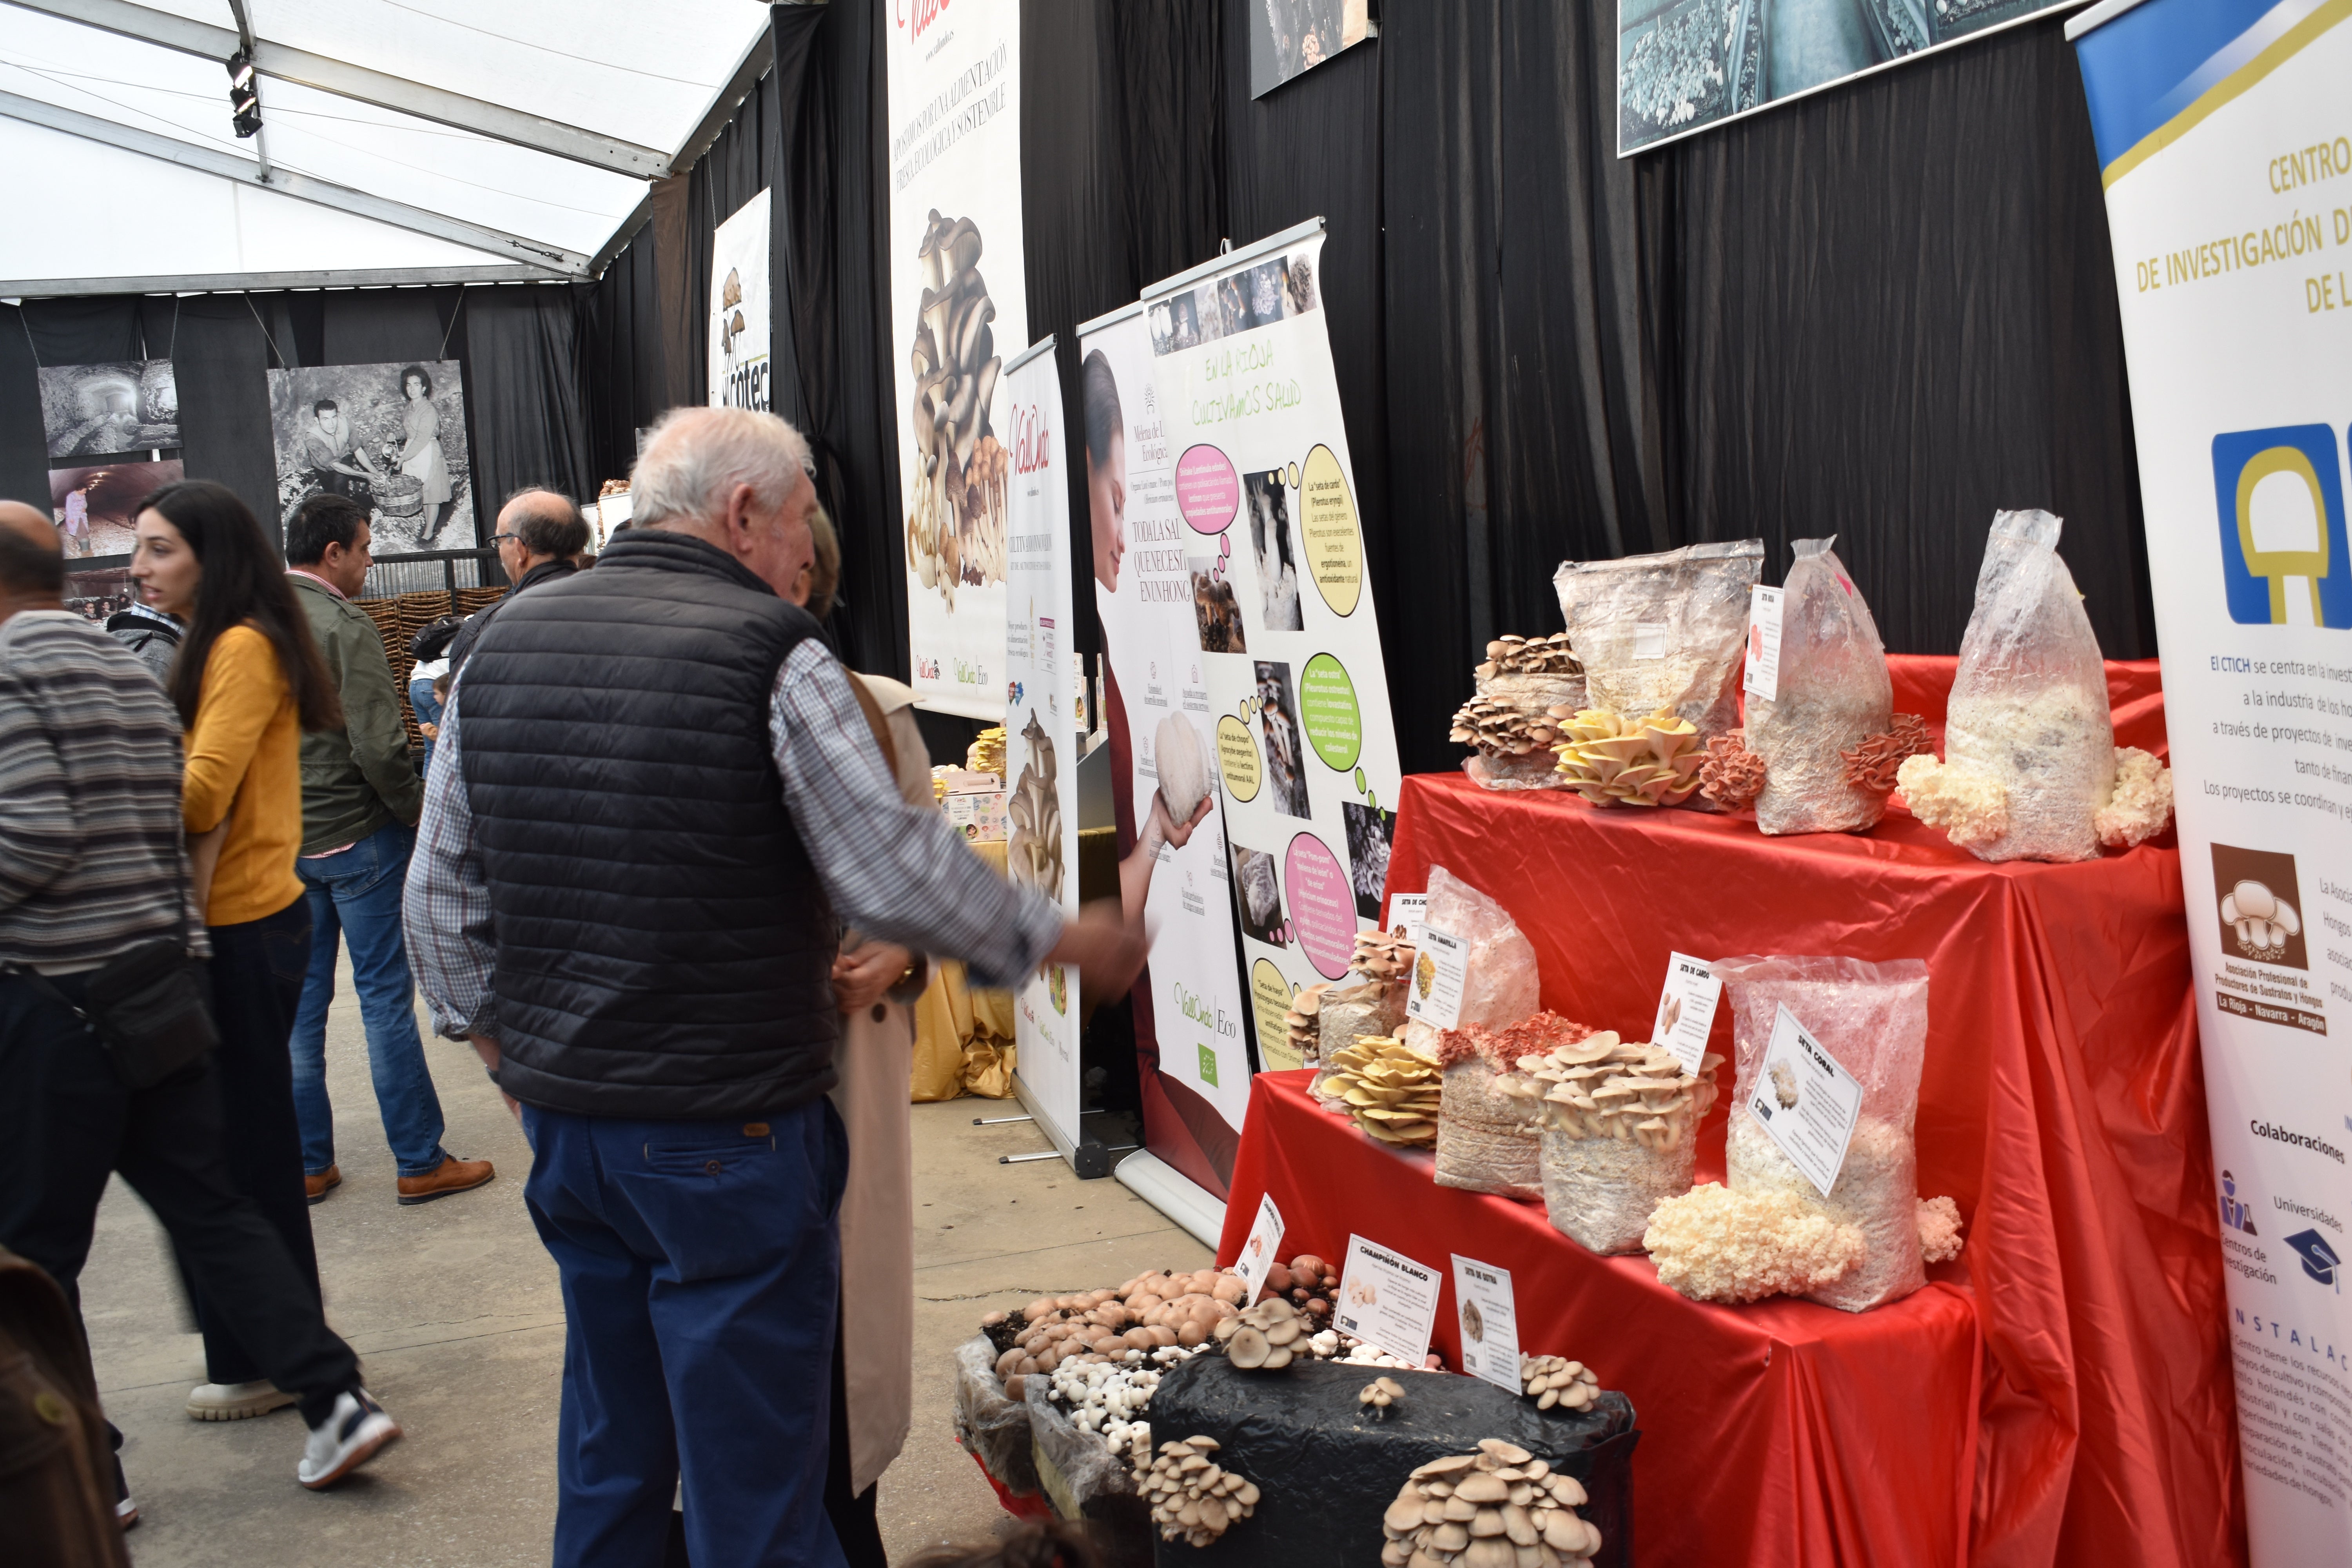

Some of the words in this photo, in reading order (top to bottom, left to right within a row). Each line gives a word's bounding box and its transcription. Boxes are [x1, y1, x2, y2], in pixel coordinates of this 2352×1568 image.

[894, 113, 922, 164] APOSTAMOS
[922, 102, 935, 135] POR
[934, 90, 948, 119] UNA
[949, 38, 1007, 111] ALIMENTACIÓN
[915, 126, 951, 175] ECOLÓGICA
[951, 118, 956, 145] Y
[956, 82, 1006, 140] SOSTENIBLE
[2269, 137, 2351, 194] CENTRO
[2136, 257, 2161, 293] DE
[2166, 209, 2323, 286] INVESTIGACIÓN
[2305, 274, 2334, 313] DE
[2339, 271, 2352, 307] L
[1222, 350, 1233, 377] LA
[1236, 339, 1274, 374] RIOJA
[1192, 385, 1260, 426] CULTIVAMOS
[1266, 378, 1301, 411] SALUD
[1152, 423, 1159, 439] de
[1132, 520, 1152, 542] TODA
[1152, 518, 1164, 542] LA
[1165, 518, 1182, 540] SAL
[1325, 543, 1338, 553] fuentes
[1134, 550, 1150, 577] QUE
[1150, 549, 1187, 572] NECESIT
[1140, 581, 1152, 602] EN
[1151, 580, 1162, 602] UN
[1162, 580, 1191, 603] HONG
[1319, 574, 1345, 583] antioxidante
[977, 665, 988, 686] Eco
[2210, 655, 2219, 671] El
[2221, 657, 2251, 673] CTICH
[2254, 661, 2267, 674] se
[2270, 660, 2305, 675] centra
[2307, 664, 2318, 677] en
[2318, 661, 2325, 679] la
[2326, 664, 2352, 683] invest
[2243, 694, 2250, 705] a
[2252, 690, 2263, 706] la
[2266, 691, 2313, 710] industria
[2317, 695, 2326, 713] de
[2327, 697, 2339, 716] los
[1310, 713, 1336, 724] compuesto
[1336, 716, 1348, 725] capaz
[1310, 727, 1327, 737] reducir
[1335, 728, 1351, 740] niveles
[2212, 722, 2218, 734] a
[2220, 720, 2250, 737] través
[2253, 722, 2268, 739] de
[2271, 726, 2321, 745] proyectos
[2322, 730, 2332, 747] de
[2335, 733, 2352, 752] inve
[1325, 744, 1348, 755] colesterol
[2295, 759, 2319, 777] tanto
[2321, 763, 2331, 780] de
[2332, 765, 2352, 785] finan
[2204, 779, 2220, 796] Los
[2222, 784, 2274, 803] proyectos
[2278, 791, 2291, 804] se
[2295, 793, 2337, 815] coordinan
[2338, 805, 2343, 820] y
[2319, 877, 2329, 894] La
[2330, 882, 2352, 904] Asocia
[2323, 911, 2351, 937] Hongos
[1680, 964, 1689, 973] SETA
[1696, 969, 1710, 980] CARDO
[2327, 948, 2352, 973] asociac
[2225, 962, 2257, 980] Asociación
[2258, 968, 2298, 988] Profesional
[2299, 976, 2308, 989] de
[2215, 974, 2249, 993] Productores
[2249, 982, 2258, 995] de
[2259, 983, 2292, 1002] Sustratos
[2293, 993, 2298, 1005] y
[2299, 993, 2323, 1009] Hongos
[2330, 981, 2352, 1003] produ
[1217, 1009, 1236, 1039] Eco
[2218, 994, 2228, 1009] La
[2229, 996, 2247, 1014] Rioja
[2255, 1004, 2288, 1022] Navarra
[2298, 1012, 2325, 1031] Aragón
[1797, 1034, 1812, 1055] SETA
[1813, 1051, 1835, 1078] CORAL
[2250, 1120, 2345, 1164] Colaboraciones
[2274, 1195, 2343, 1234] Universidades
[1360, 1246, 1399, 1269] CHAMPIÑÓN
[1401, 1264, 1428, 1281] BLANCO
[2254, 1247, 2267, 1263] de
[2222, 1253, 2277, 1285] nvestigación
[2235, 1334, 2261, 1355] Centro
[2264, 1347, 2288, 1365] tiene
[2290, 1355, 2305, 1371] los
[2307, 1364, 2339, 1389] recursos
[2260, 1362, 2271, 1376] de
[2273, 1368, 2304, 1389] cultivo
[2258, 1378, 2305, 1406] holandés
[2310, 1401, 2326, 1416] con
[2293, 1412, 2310, 1427] con
[2290, 1444, 2303, 1457] de
[2311, 1433, 2333, 1456] Tiene
[2289, 1477, 2301, 1491] de
